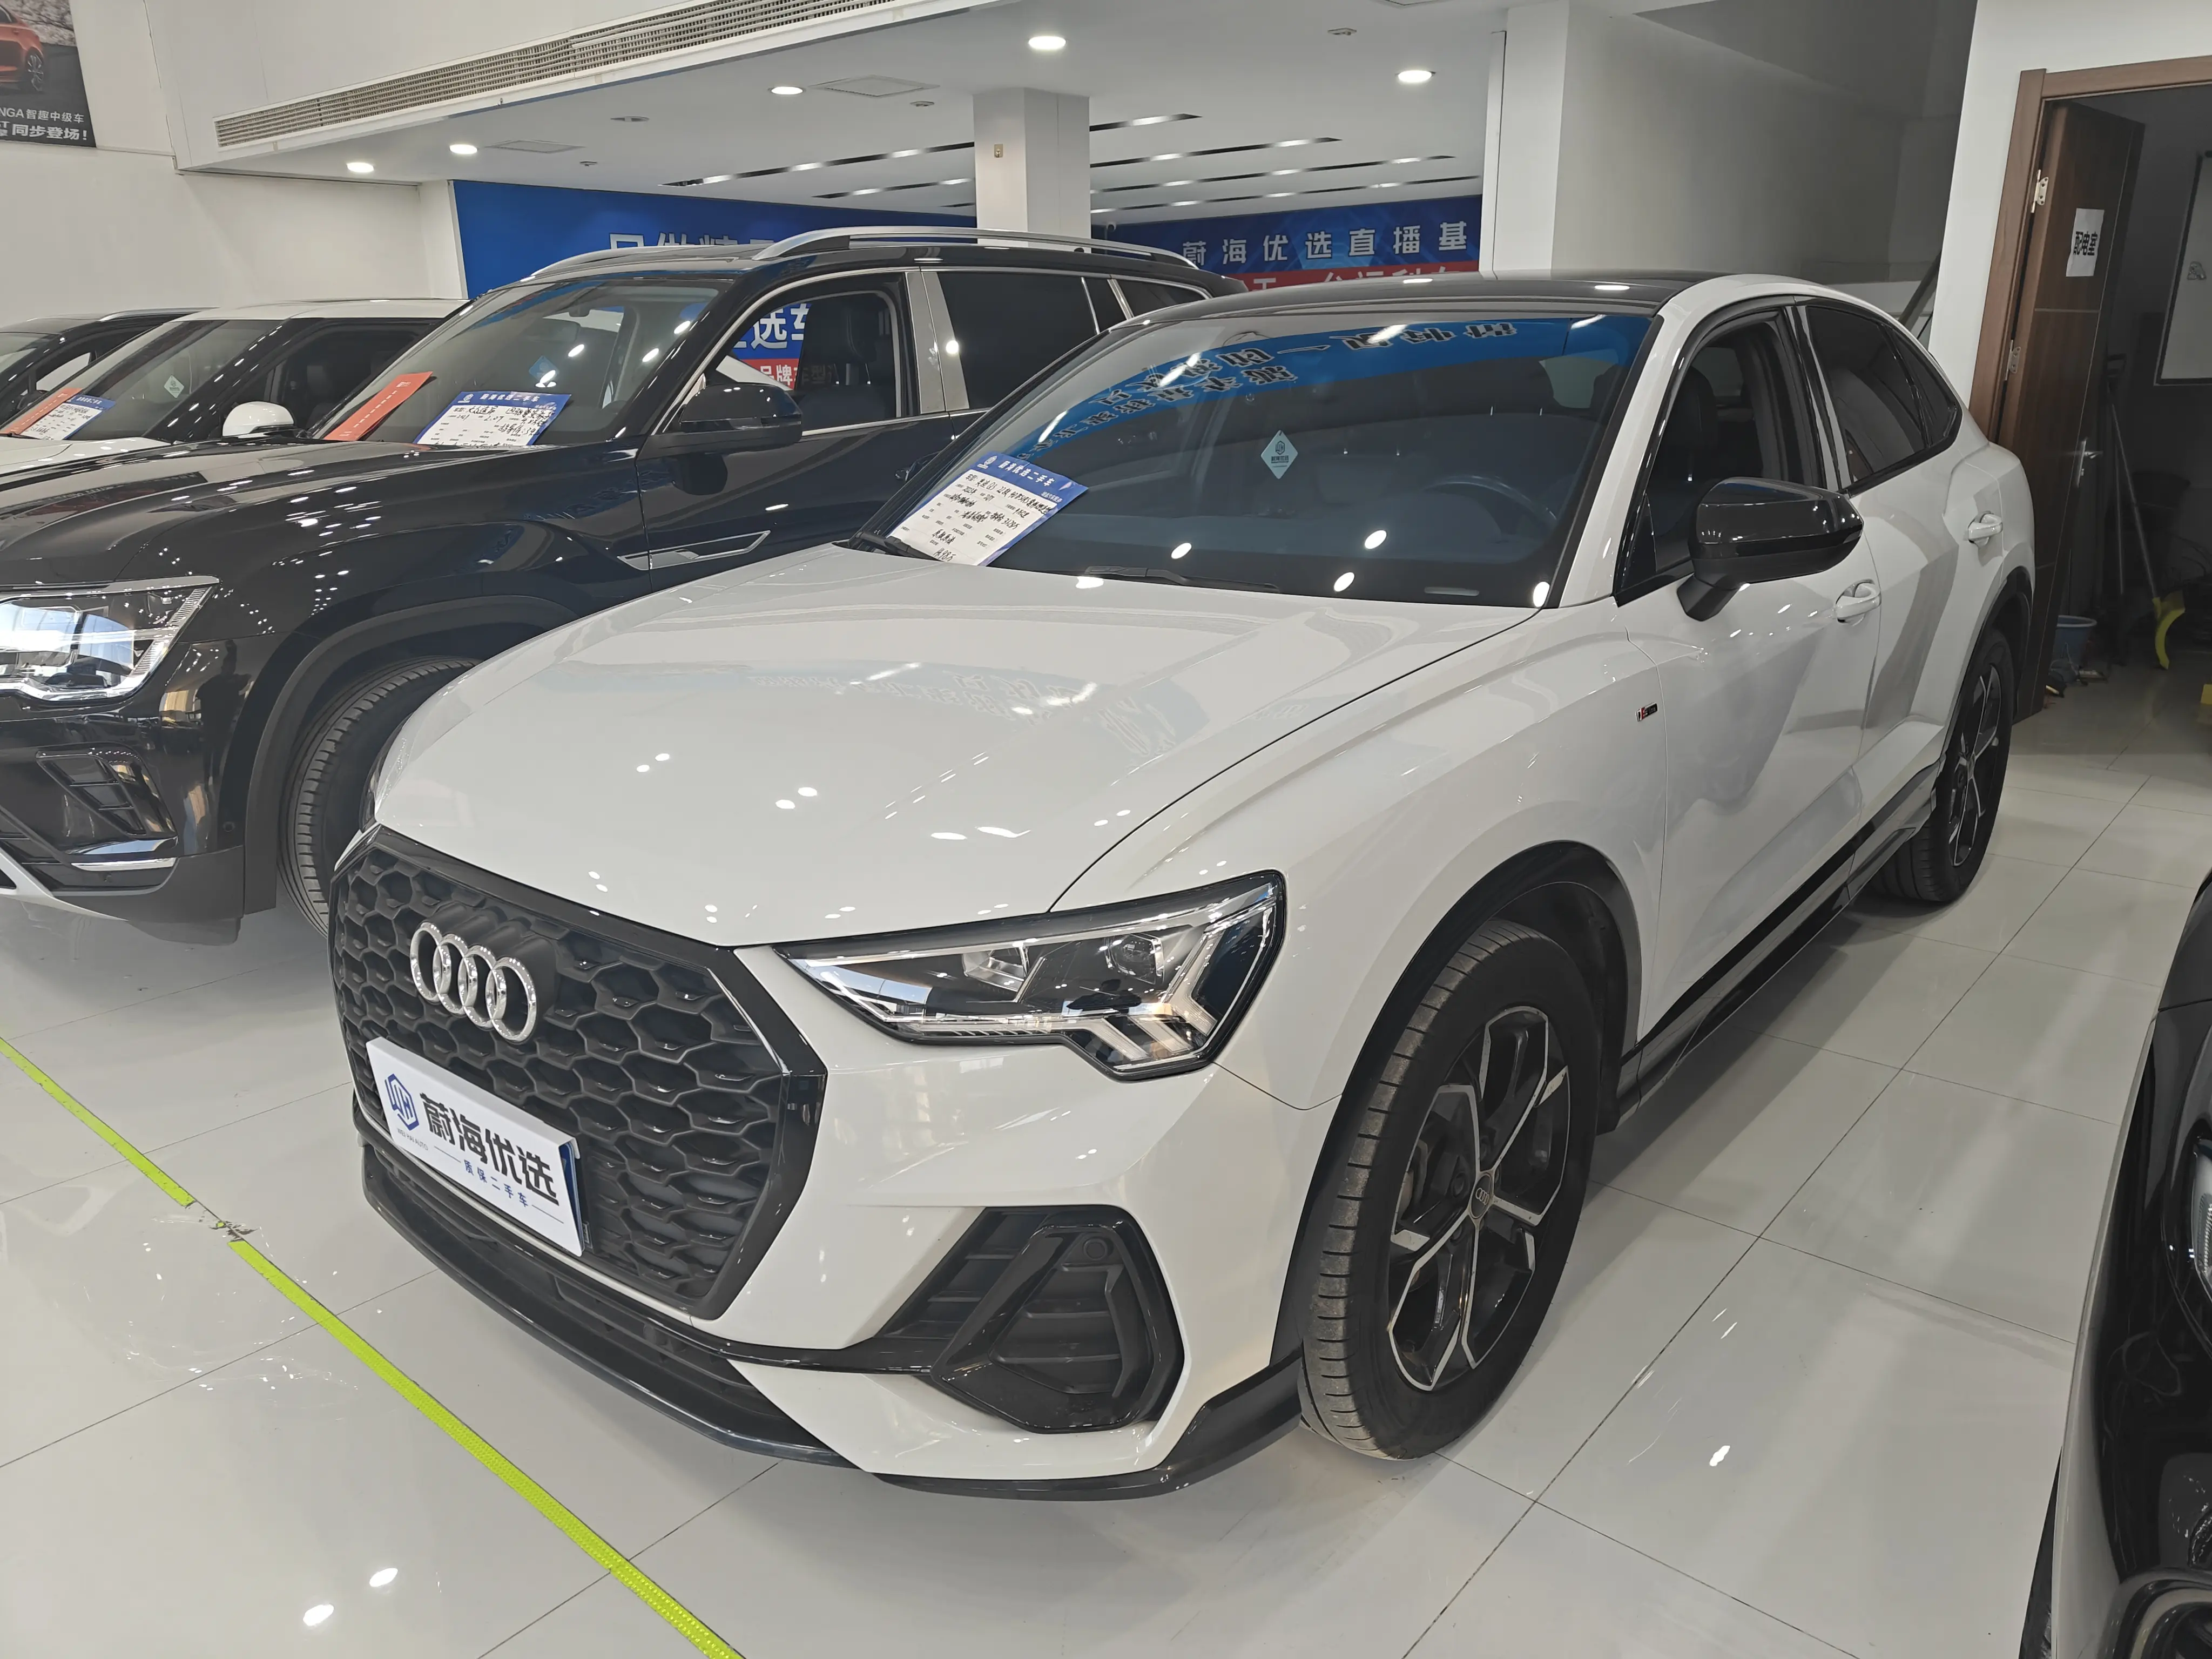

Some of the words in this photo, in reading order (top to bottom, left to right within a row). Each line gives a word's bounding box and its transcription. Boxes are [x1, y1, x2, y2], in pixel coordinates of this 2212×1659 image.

[26, 109, 84, 124] 智趣中级车
[1182, 220, 1467, 266] 蔚海优选直播基
[2073, 231, 2098, 256] 配电室
[733, 303, 810, 350] 选车
[420, 1092, 559, 1206] 蔚海优选
[463, 1159, 528, 1208] 质保二手车
